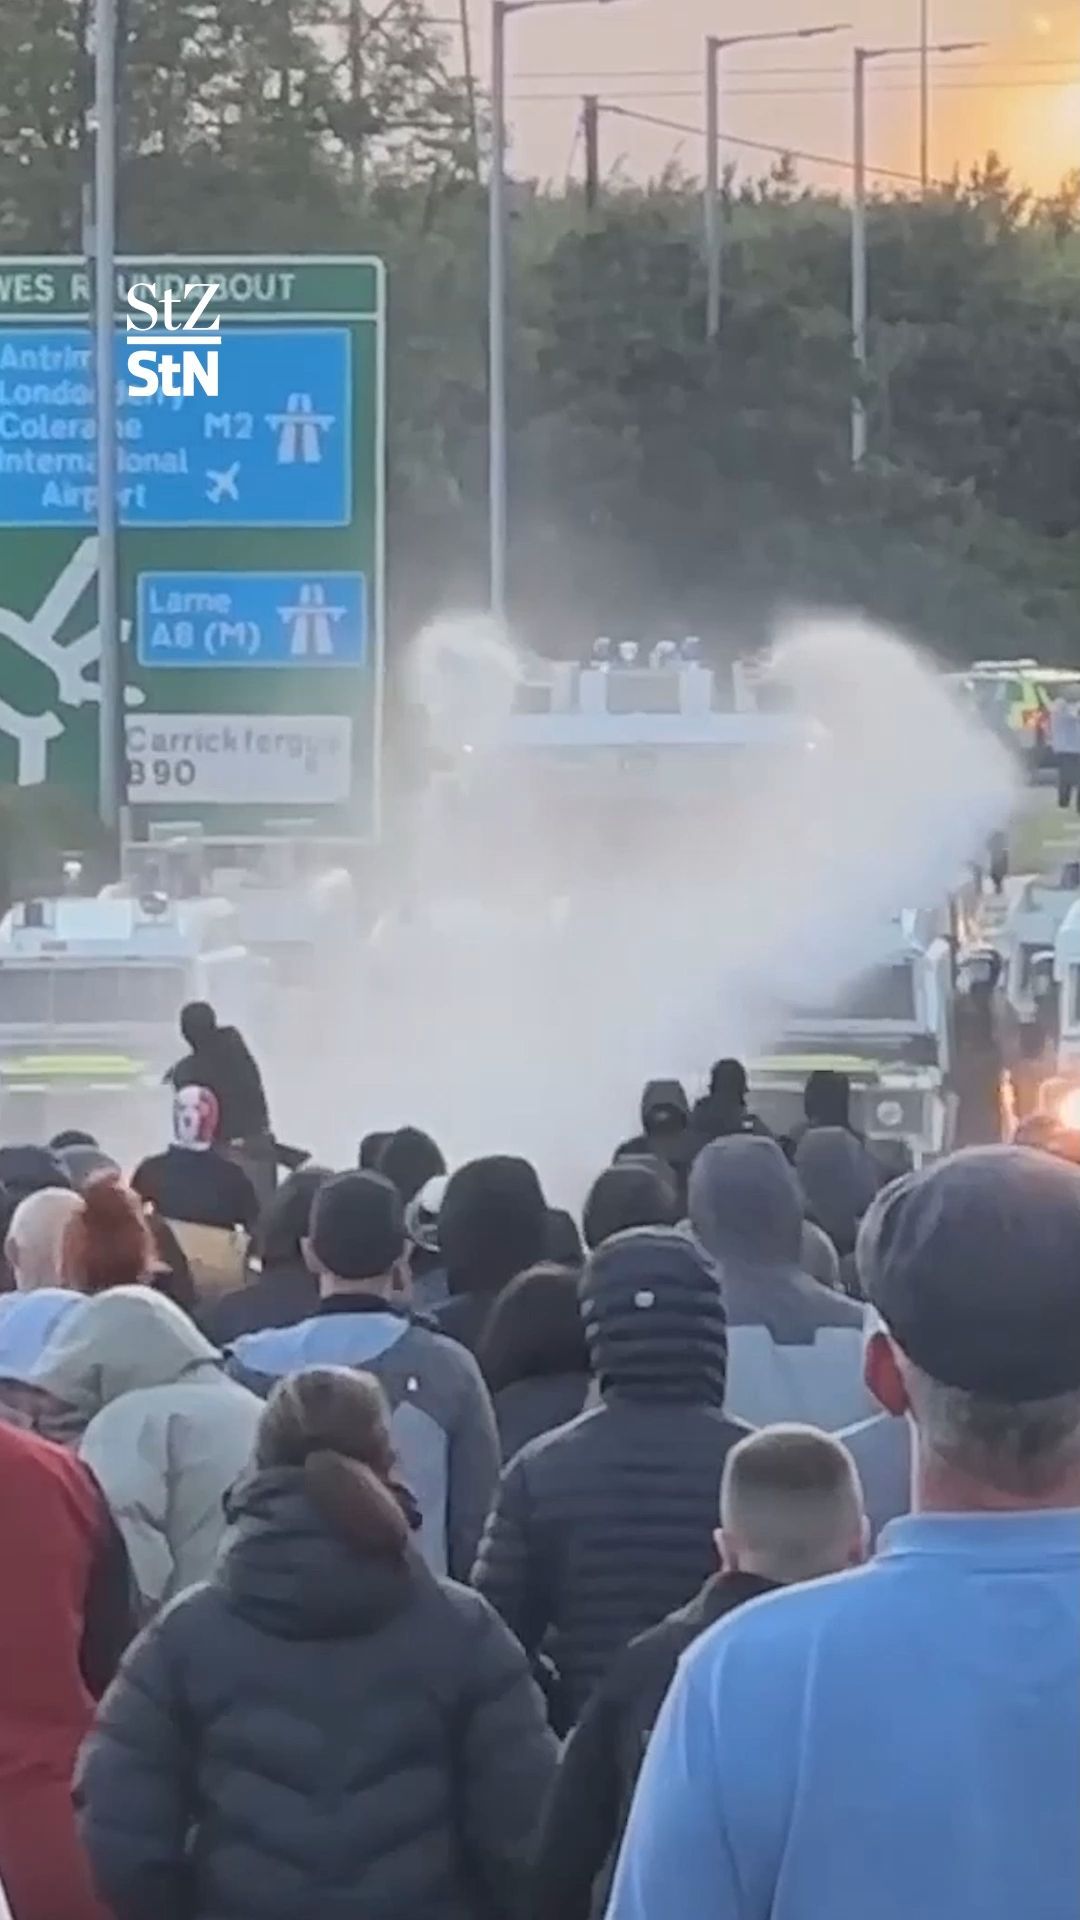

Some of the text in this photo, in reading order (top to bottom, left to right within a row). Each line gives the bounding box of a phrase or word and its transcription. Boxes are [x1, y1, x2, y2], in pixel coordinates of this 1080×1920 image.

[71, 272, 296, 303] RUNDABOUT
[0, 411, 143, 440] Colerae
[204, 412, 253, 439] M2
[0, 447, 188, 474] Internaional
[41, 480, 147, 513] Airprt
[150, 586, 232, 614] Larne
[126, 725, 341, 760] Carrickferg
